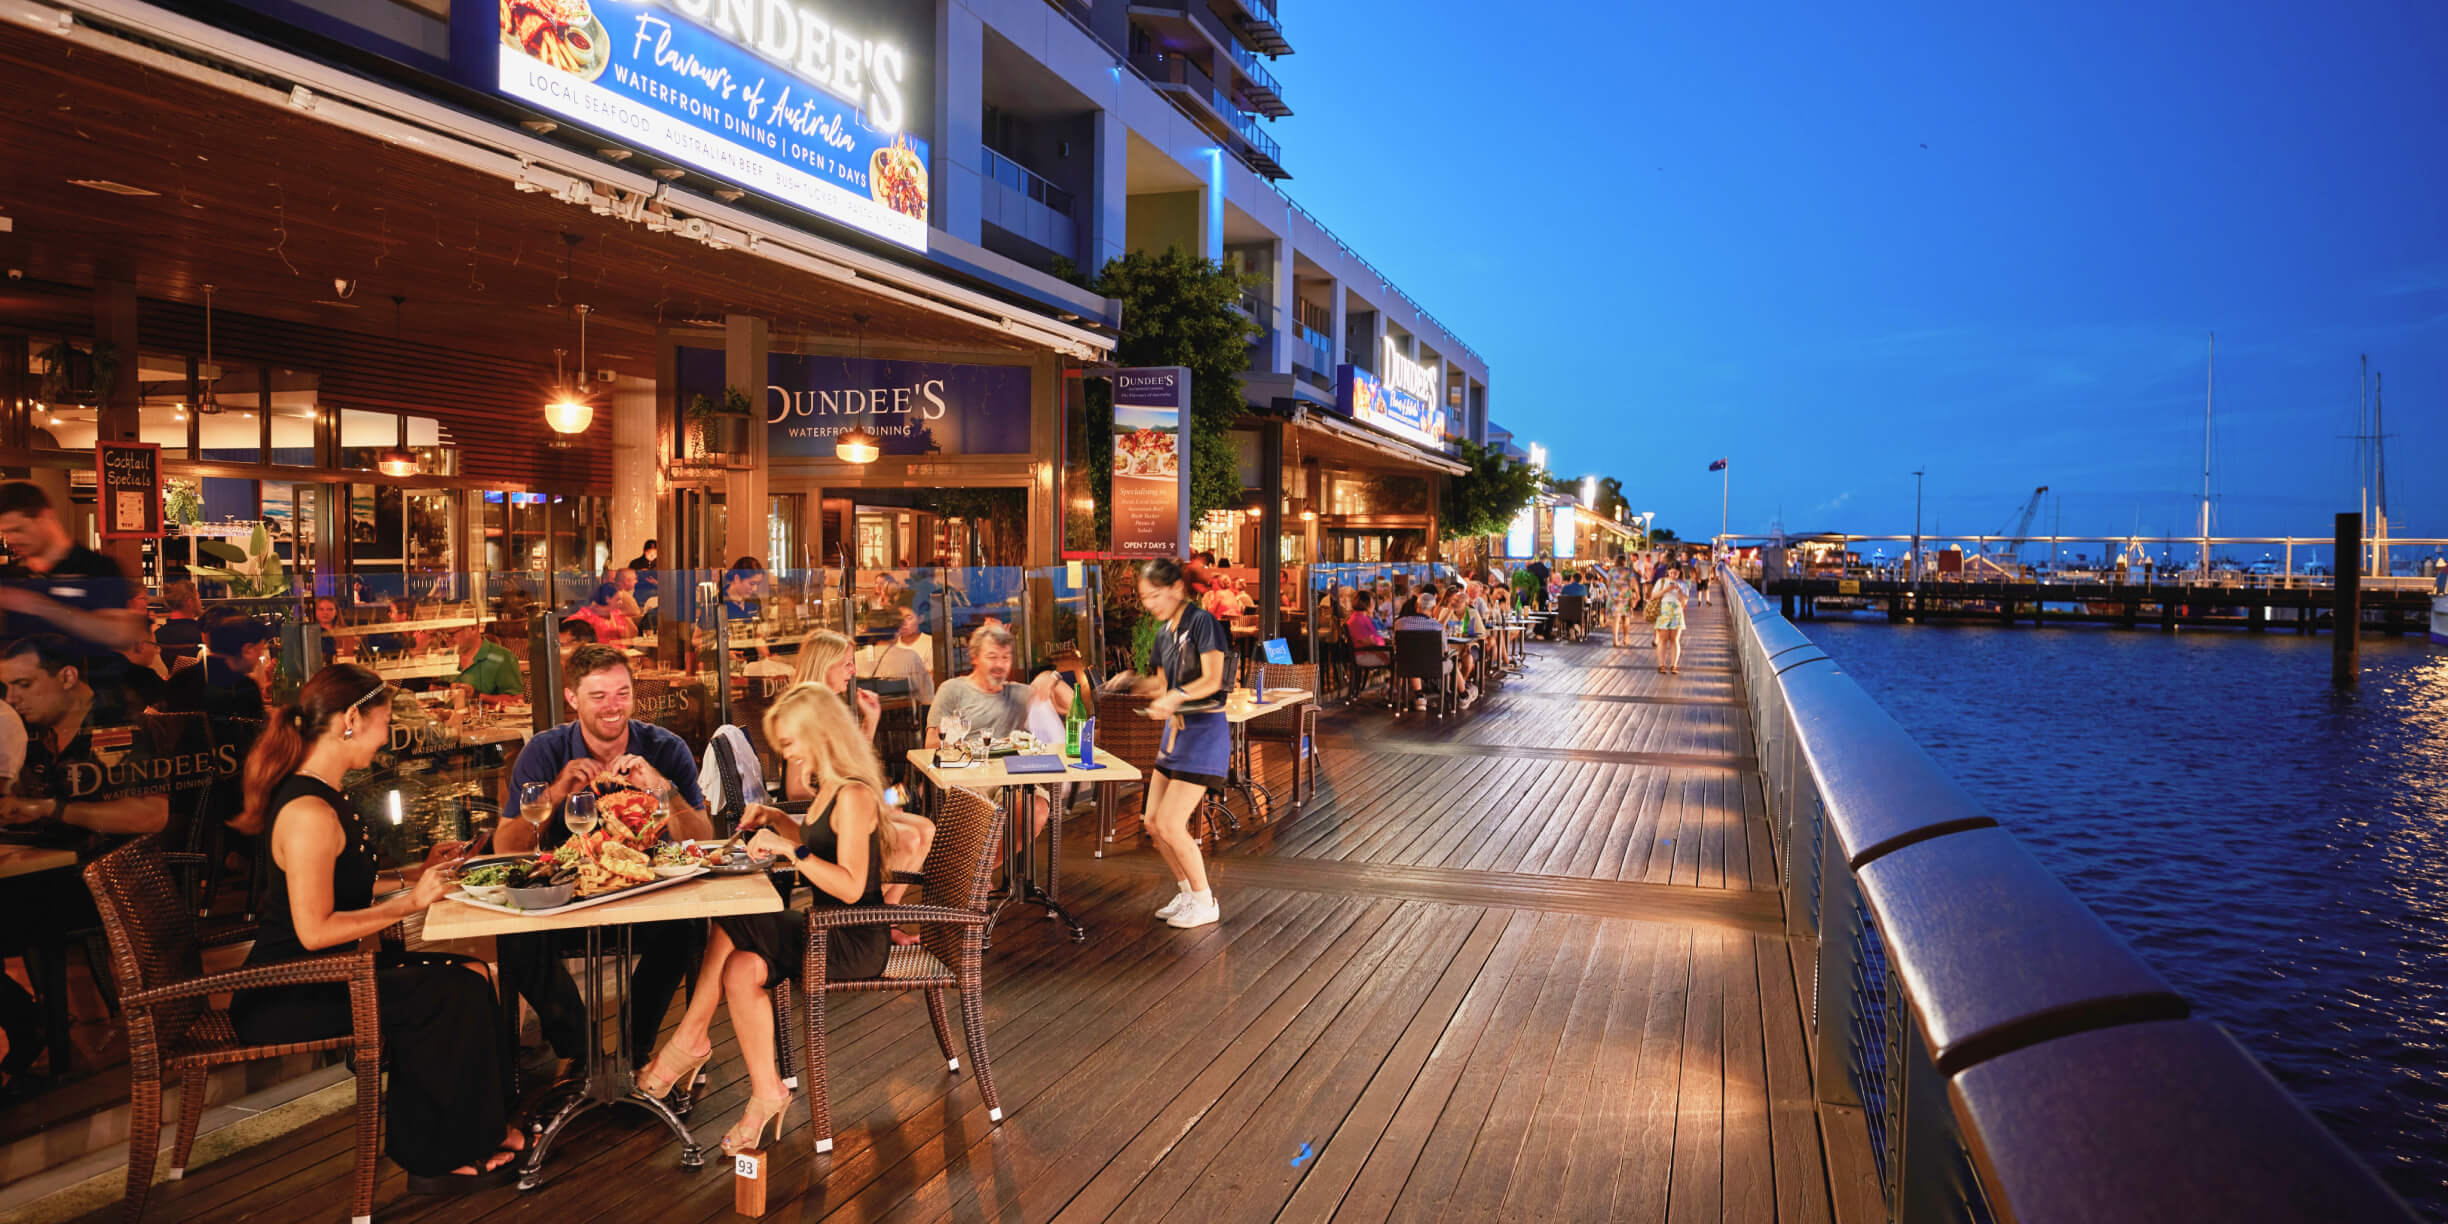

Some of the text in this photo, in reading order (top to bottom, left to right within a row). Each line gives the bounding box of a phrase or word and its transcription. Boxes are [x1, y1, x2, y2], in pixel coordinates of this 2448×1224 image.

[634, 12, 855, 152] Flavours of Australia
[672, 0, 904, 133] NDEE'S
[529, 71, 578, 104] LOCAL
[585, 94, 649, 132] SEAFOOD
[665, 128, 736, 166] AUSTRALIAN
[740, 158, 763, 176] BEEF
[614, 63, 720, 124] WATERFRONT
[725, 113, 776, 148] DINING
[791, 144, 825, 170] OPEN
[828, 159, 835, 173] 7
[838, 164, 866, 188] DAYS
[1120, 375, 1174, 387] DUNDEE'S
[768, 380, 946, 424] DUNDEE'S
[869, 425, 911, 436] DINING
[105, 450, 150, 475] Cocktail
[107, 470, 151, 491] Specials
[1124, 541, 1167, 549] OPEN 7 DAYS
[66, 743, 238, 798] DUNDEE'S
[738, 1159, 753, 1175] 93
